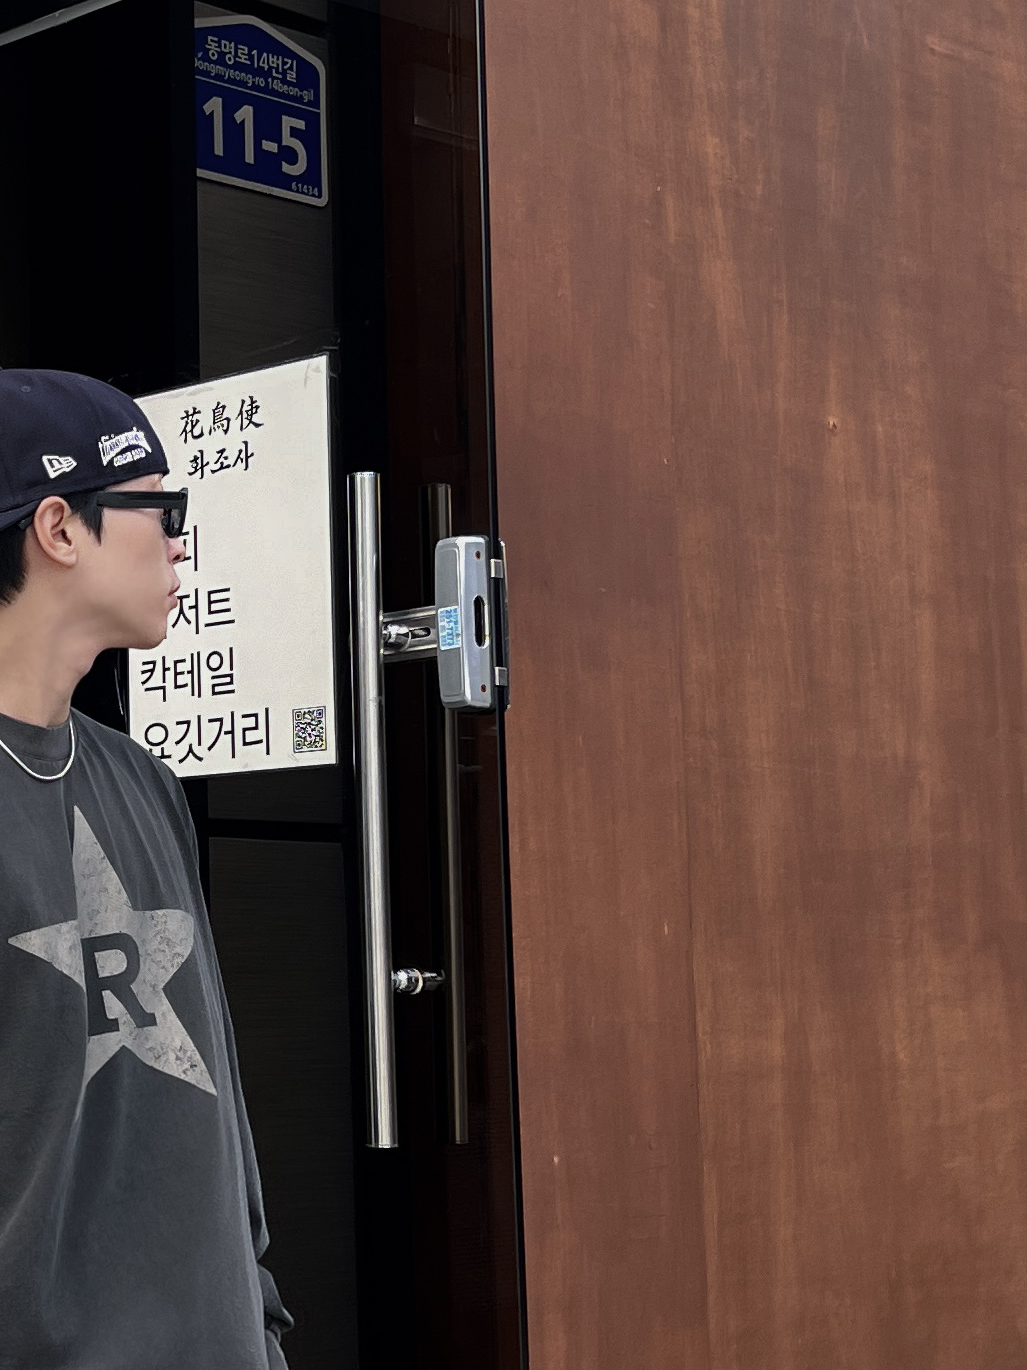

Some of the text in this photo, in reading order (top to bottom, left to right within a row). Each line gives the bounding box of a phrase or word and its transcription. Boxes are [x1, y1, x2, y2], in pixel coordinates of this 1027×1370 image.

[205, 35, 297, 83] 동명로14번길
[268, 77, 314, 102] 14beon-gil
[202, 96, 308, 176] 11-5
[291, 181, 319, 197] 61434
[179, 395, 265, 445] 花鳥使
[187, 440, 255, 480] 화조사
[171, 587, 236, 635] 저트
[140, 647, 236, 702] 칵테일
[144, 707, 271, 764] 요깃거리
[81, 932, 158, 1038] R
